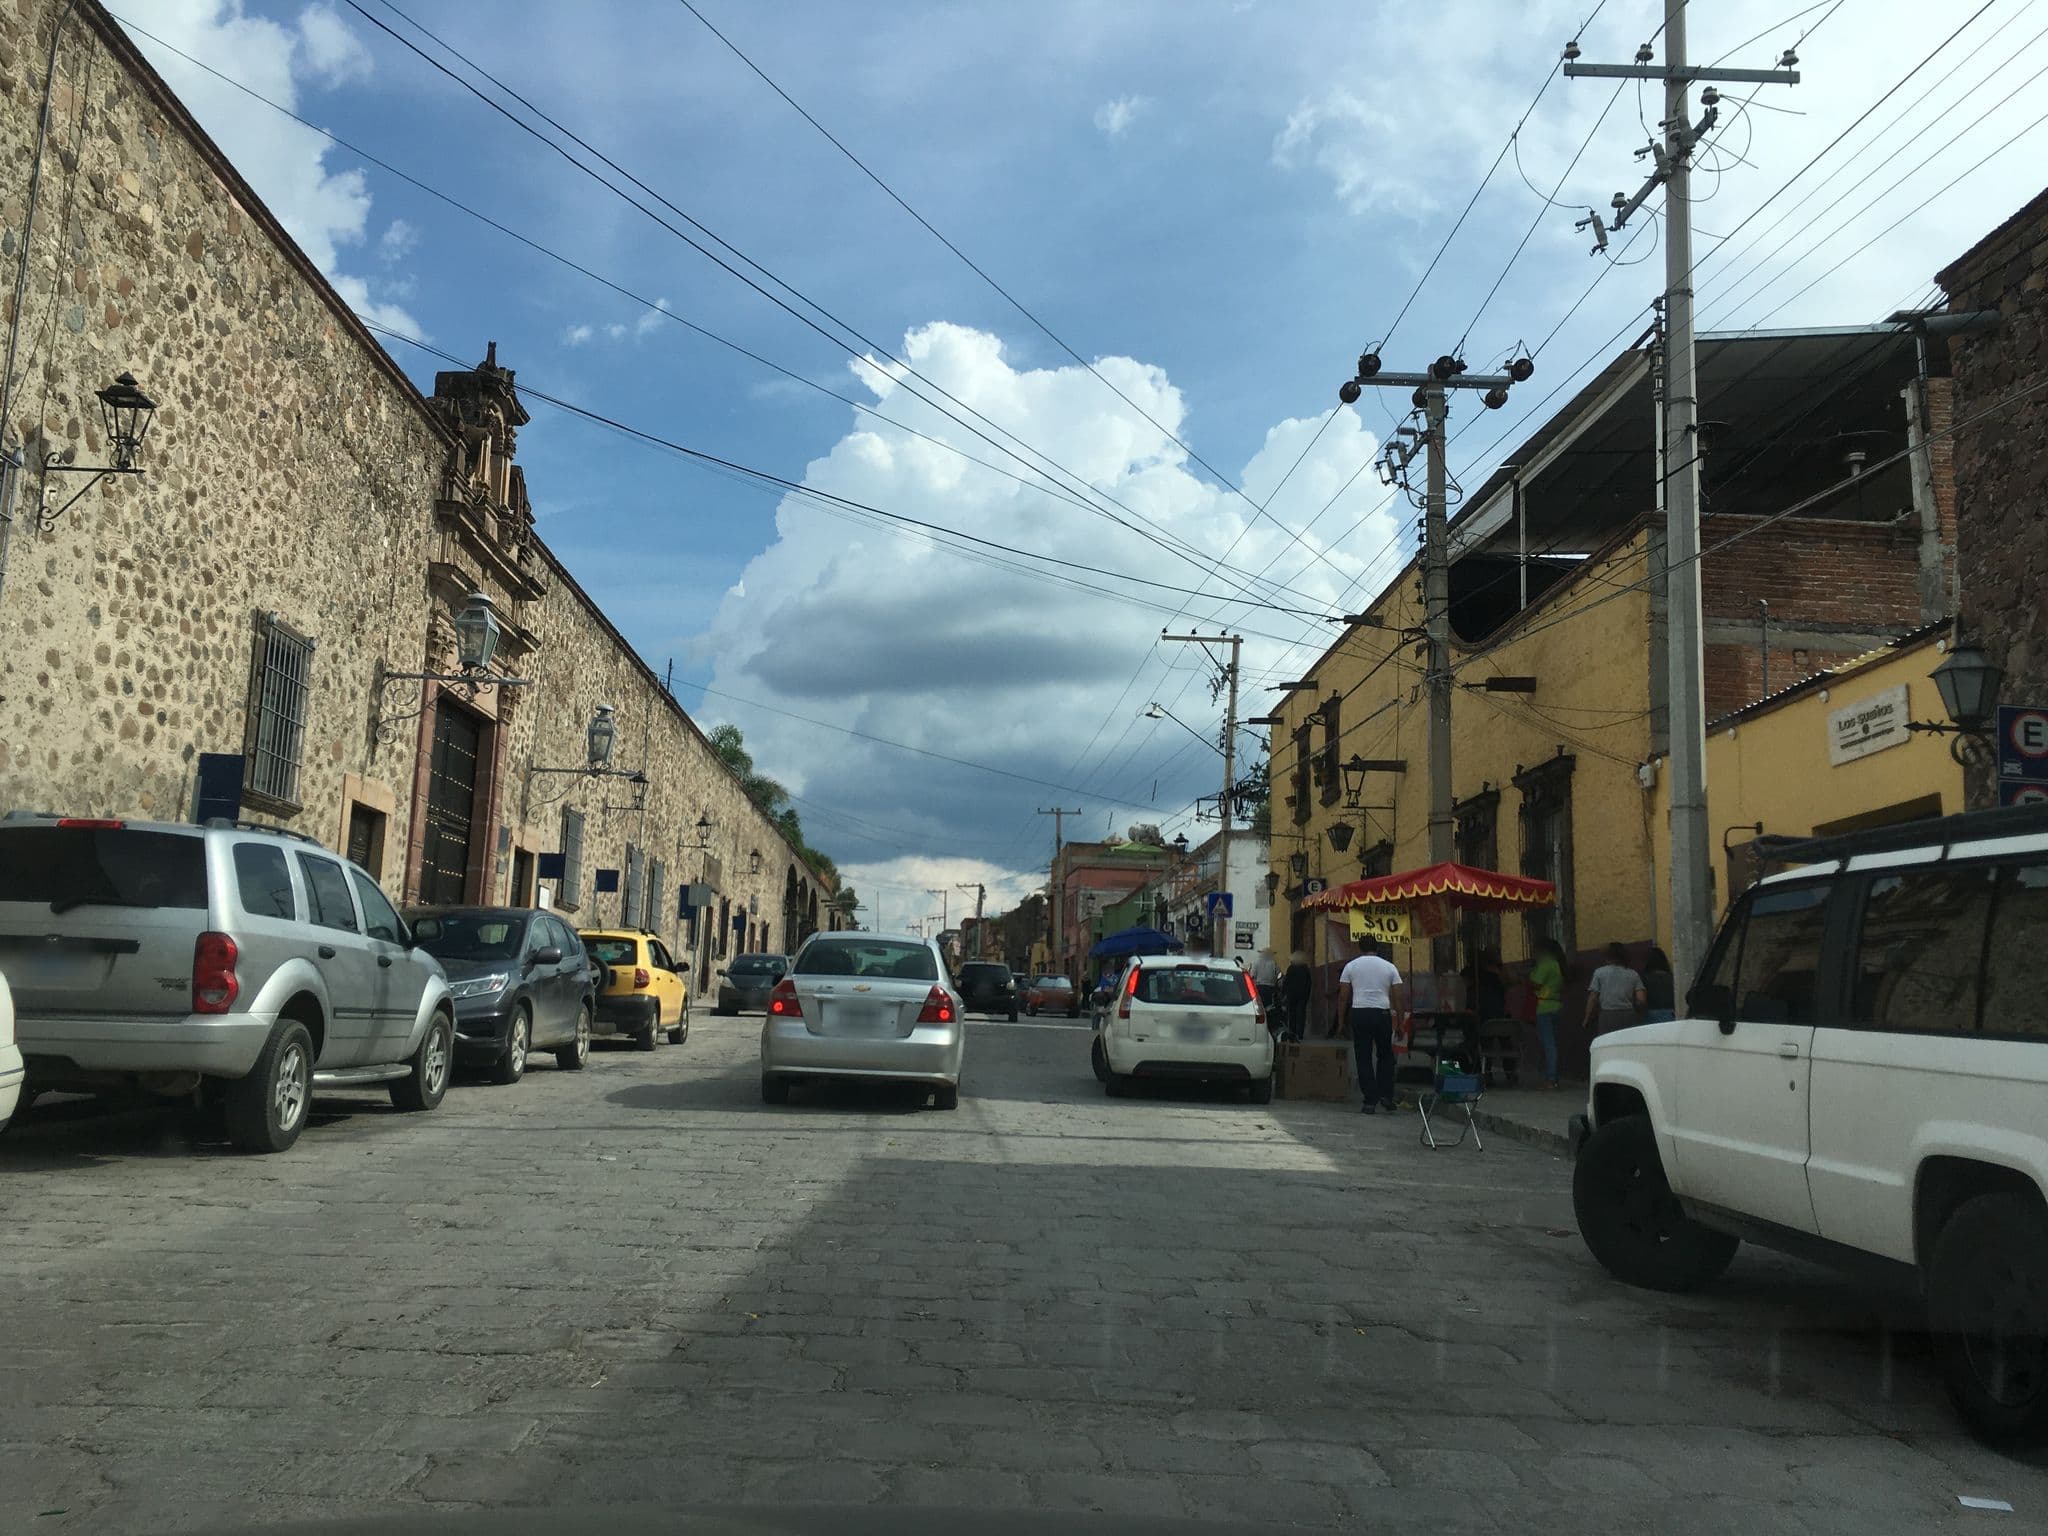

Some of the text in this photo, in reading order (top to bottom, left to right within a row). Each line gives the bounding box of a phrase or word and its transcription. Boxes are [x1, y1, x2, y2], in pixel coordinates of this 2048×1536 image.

[2023, 721, 2044, 747] E
[1364, 914, 1399, 932] $10
[1385, 935, 1410, 944] LITRO
